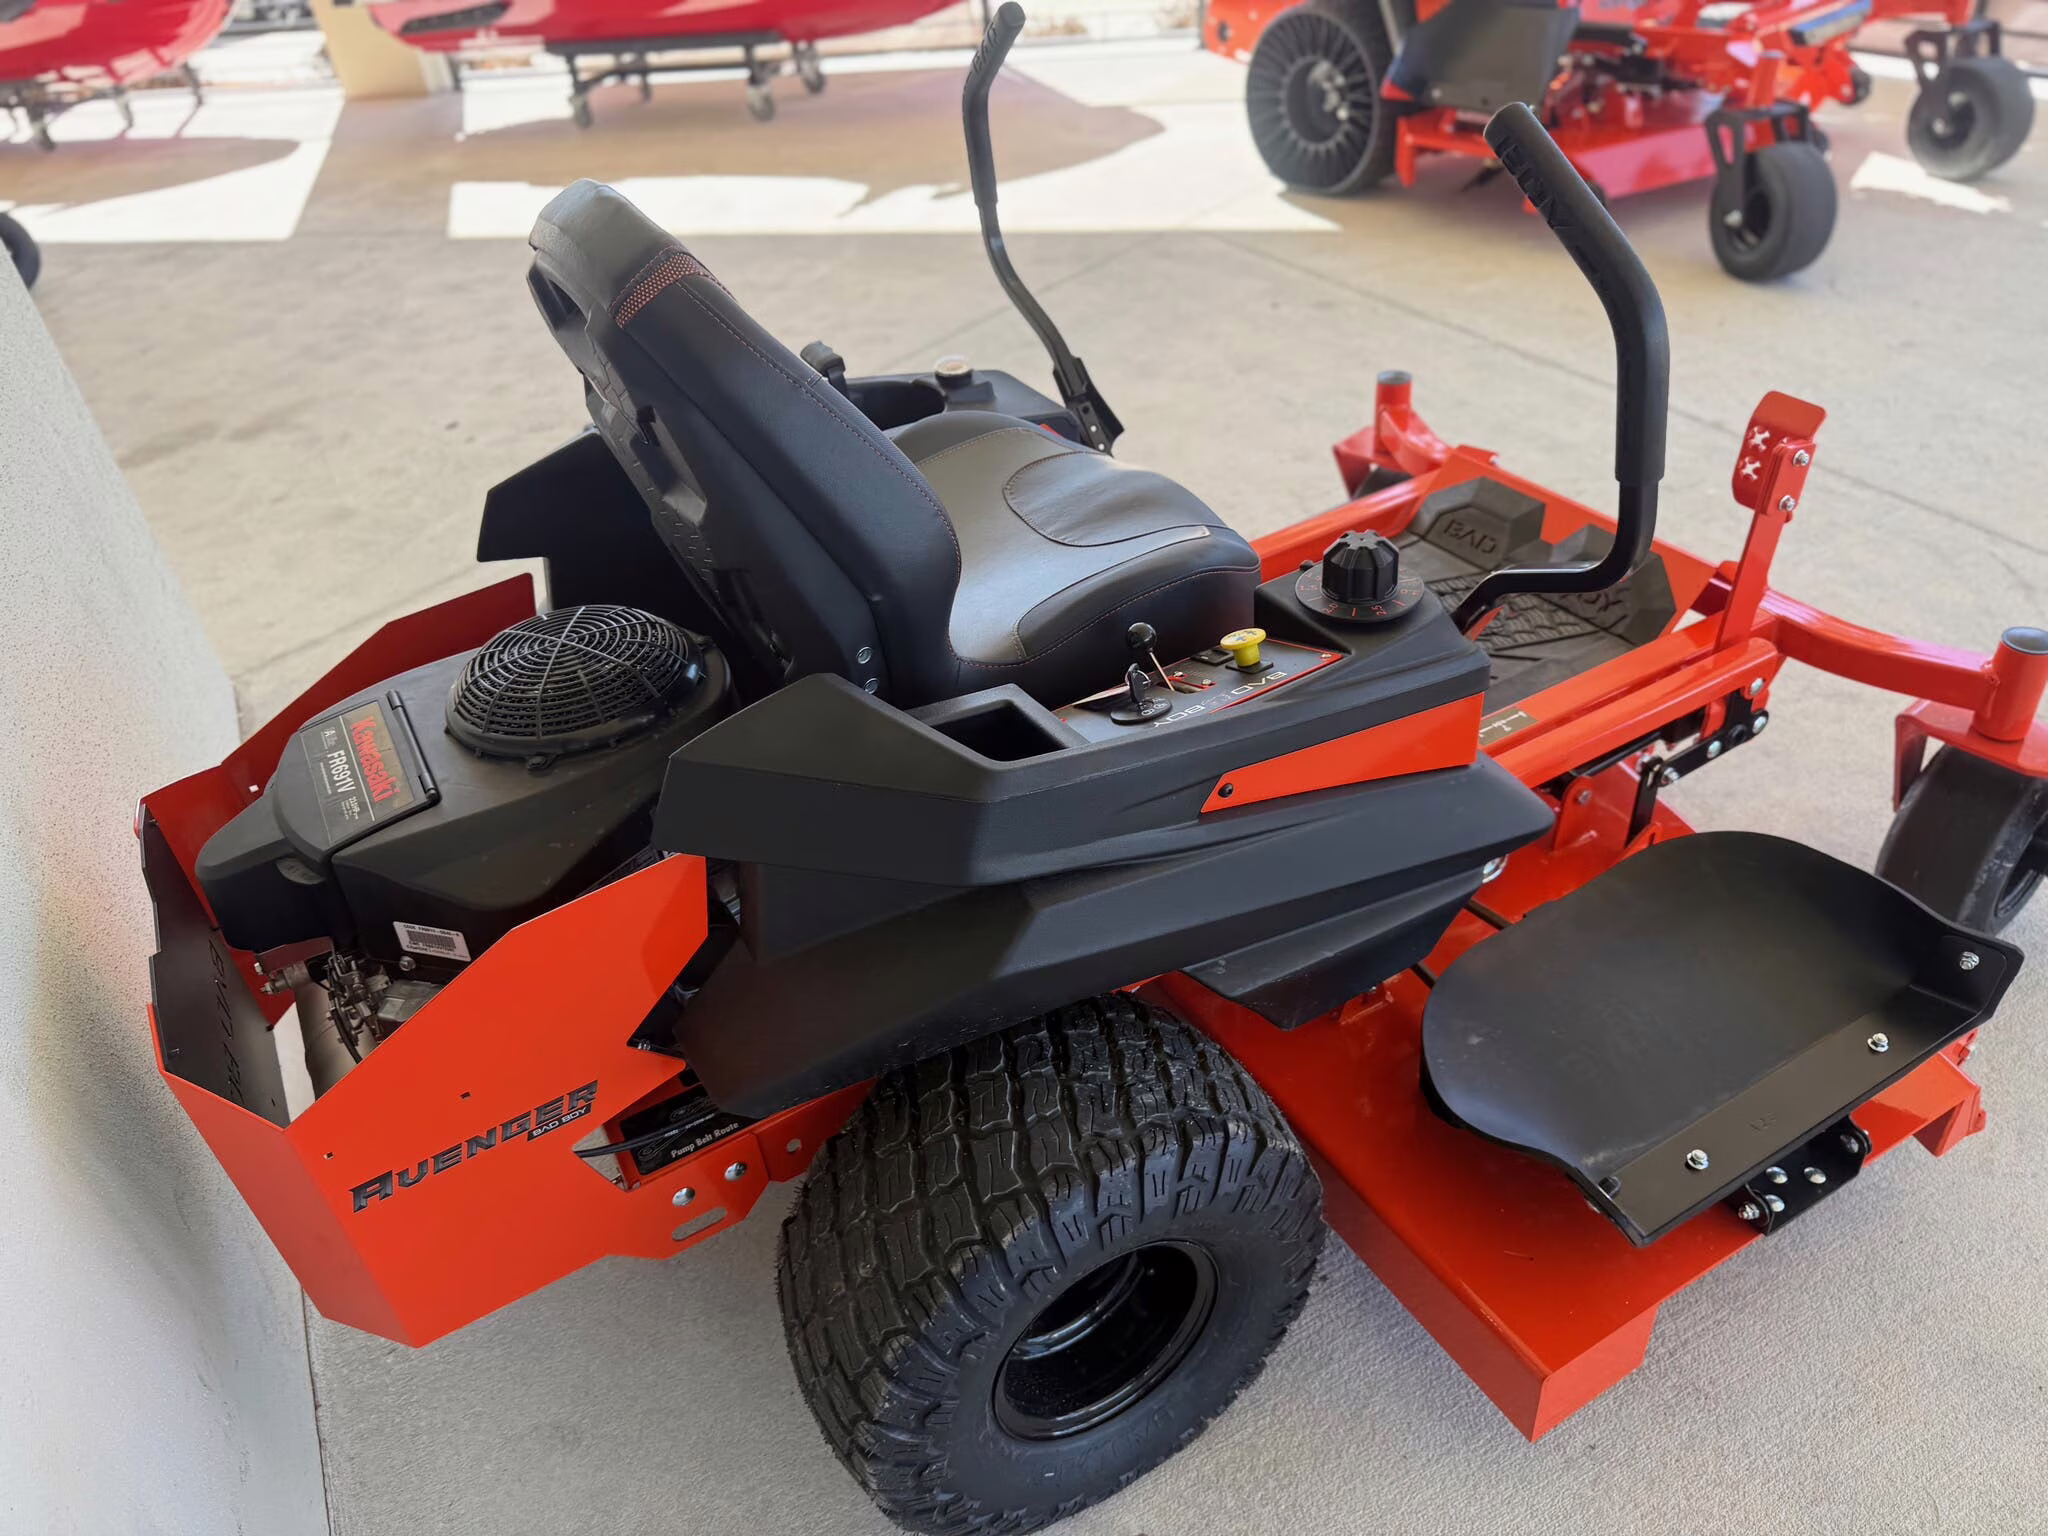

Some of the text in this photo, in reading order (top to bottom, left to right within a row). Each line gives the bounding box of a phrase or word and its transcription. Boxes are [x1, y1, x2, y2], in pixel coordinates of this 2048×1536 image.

[1231, 671, 1287, 695] BAD
[1152, 705, 1205, 728] BOY
[327, 750, 356, 793] FR691V
[351, 717, 400, 803] Kawasaki
[532, 1107, 588, 1137] BAD BOY
[671, 1143, 695, 1159] Pump
[696, 1134, 713, 1147] Belt
[713, 1122, 740, 1137] Route
[348, 1080, 598, 1213] AVENGER
